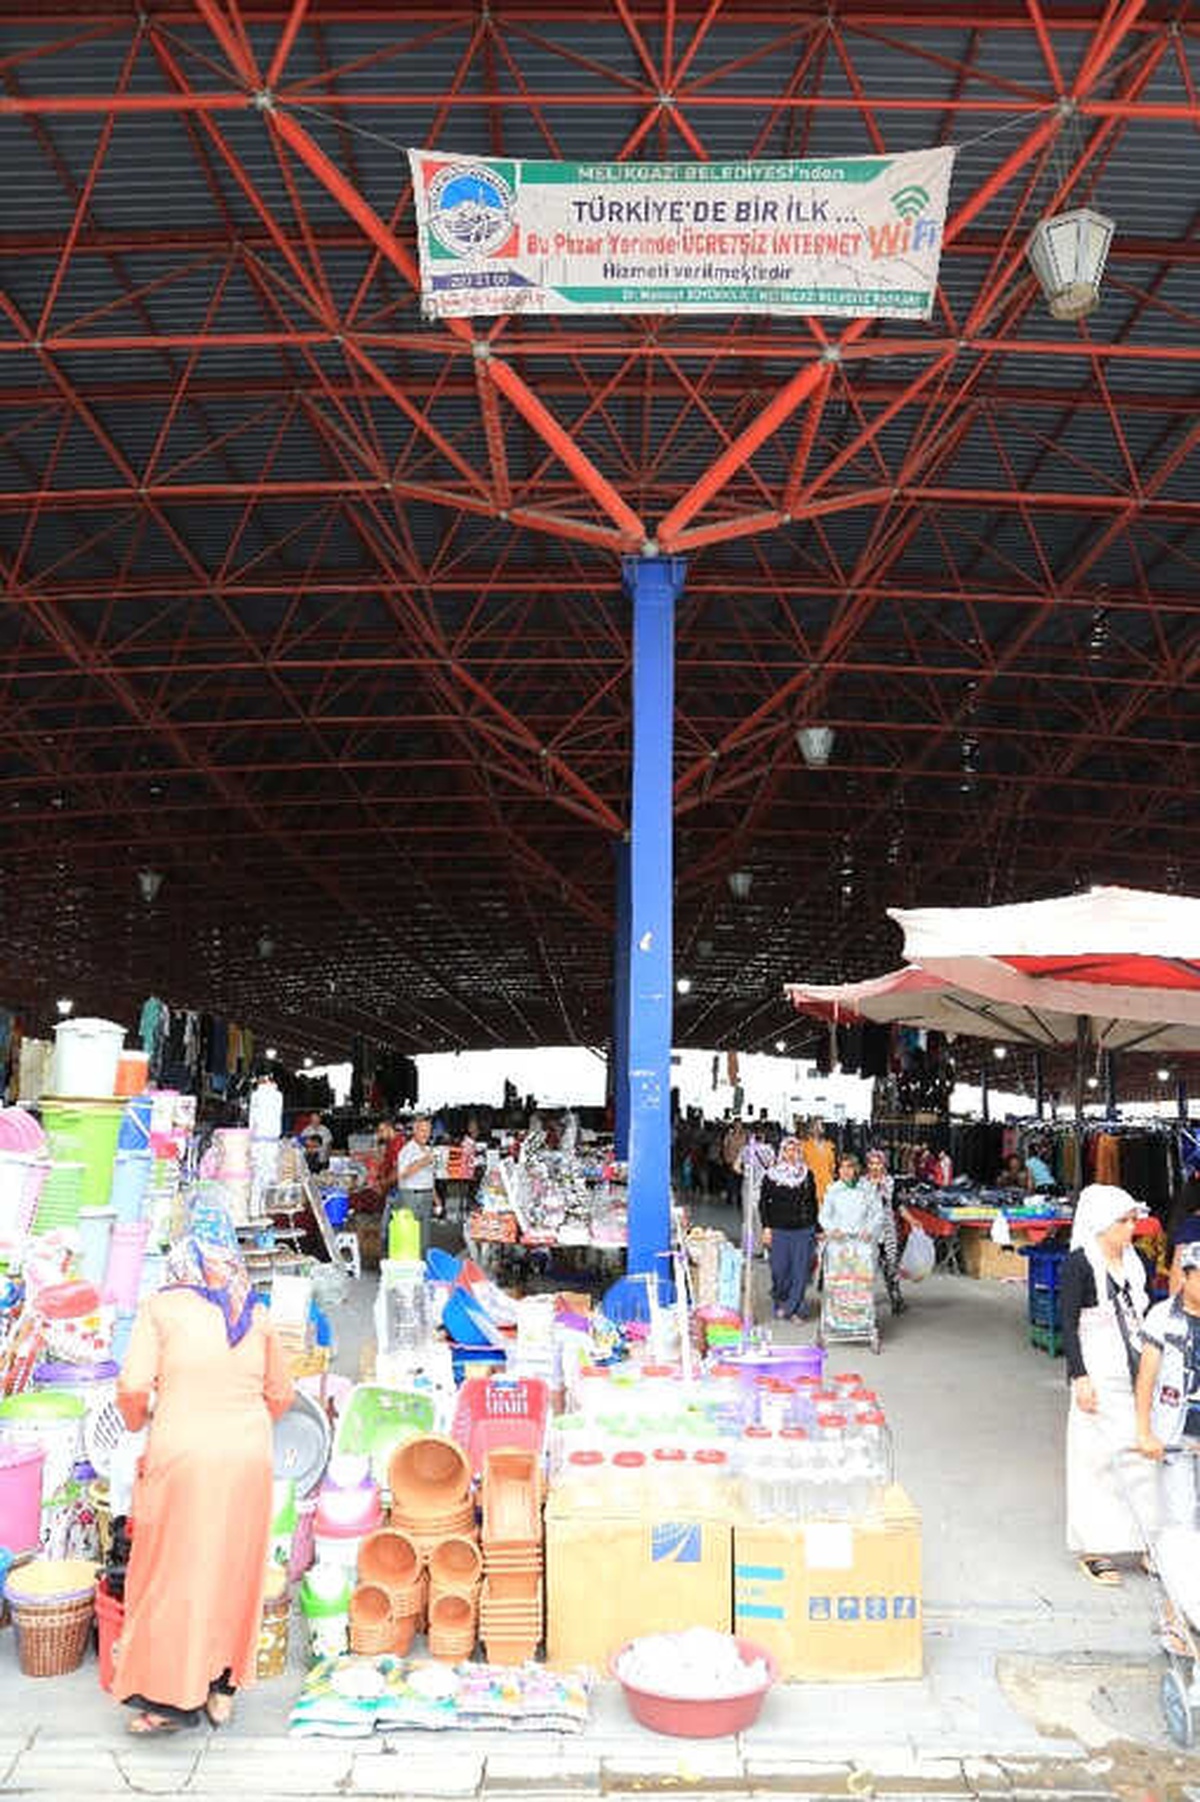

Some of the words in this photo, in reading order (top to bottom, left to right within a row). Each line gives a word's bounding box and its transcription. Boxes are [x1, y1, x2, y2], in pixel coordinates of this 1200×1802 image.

[572, 196, 727, 223] TÜRKİYE'DE
[735, 196, 778, 222] BİR
[785, 194, 828, 222] İLK
[526, 233, 549, 255] Bu
[554, 233, 602, 255] Pazar
[609, 230, 677, 255] Yerinde
[682, 227, 768, 255] ÜCRETSİZ
[603, 263, 669, 280] Hizmeti
[674, 263, 793, 281] verilmektedir
